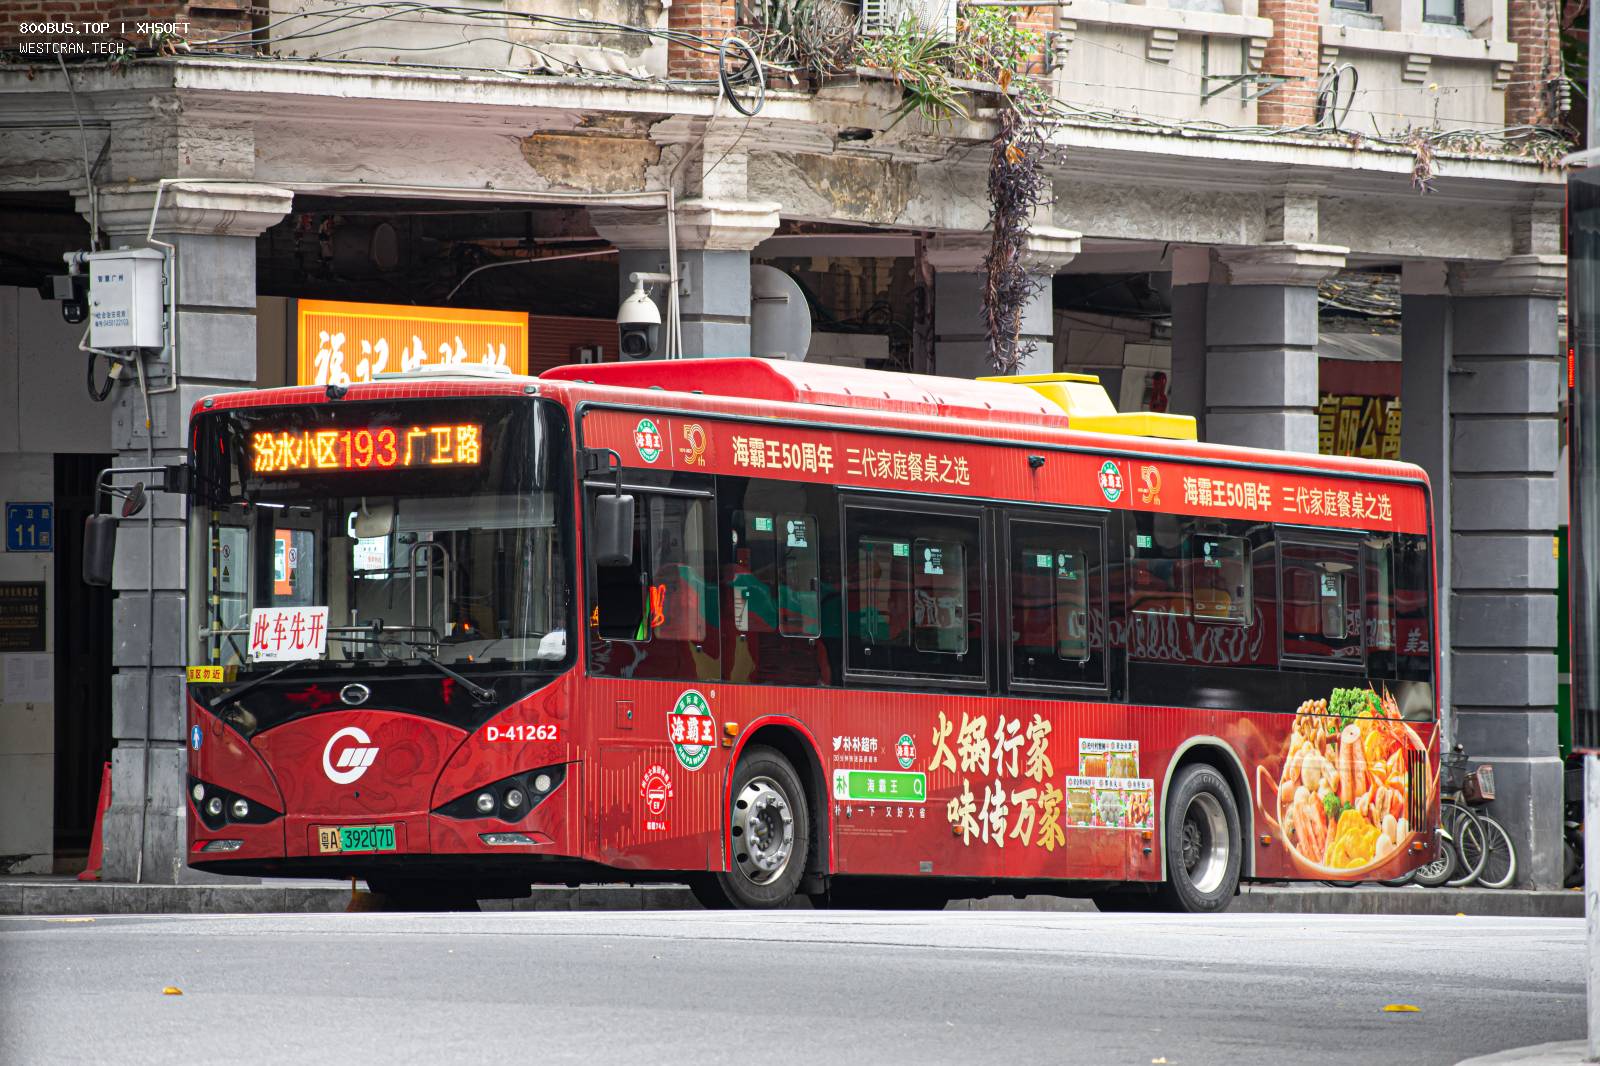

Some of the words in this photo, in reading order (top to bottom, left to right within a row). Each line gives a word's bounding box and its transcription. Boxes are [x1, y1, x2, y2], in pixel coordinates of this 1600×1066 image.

[253, 430, 338, 472] 汾水小区
[340, 428, 397, 469] 193
[404, 424, 479, 466] 广卫路
[732, 435, 834, 475] 海霸王50周年
[846, 447, 971, 486] 三代家庭餐桌之选
[1183, 476, 1272, 512] 海霸王50周年
[1282, 486, 1393, 521] 三代家庭餐桌之选
[15, 523, 36, 546] 11
[252, 611, 324, 650] 此车先开
[486, 724, 557, 741] D-41262
[670, 715, 714, 743] 海霸王
[842, 735, 879, 753] 朴朴超市
[927, 710, 1055, 782] 火锅行家
[946, 778, 1066, 852] 味传万家
[344, 829, 394, 849] 39207D
